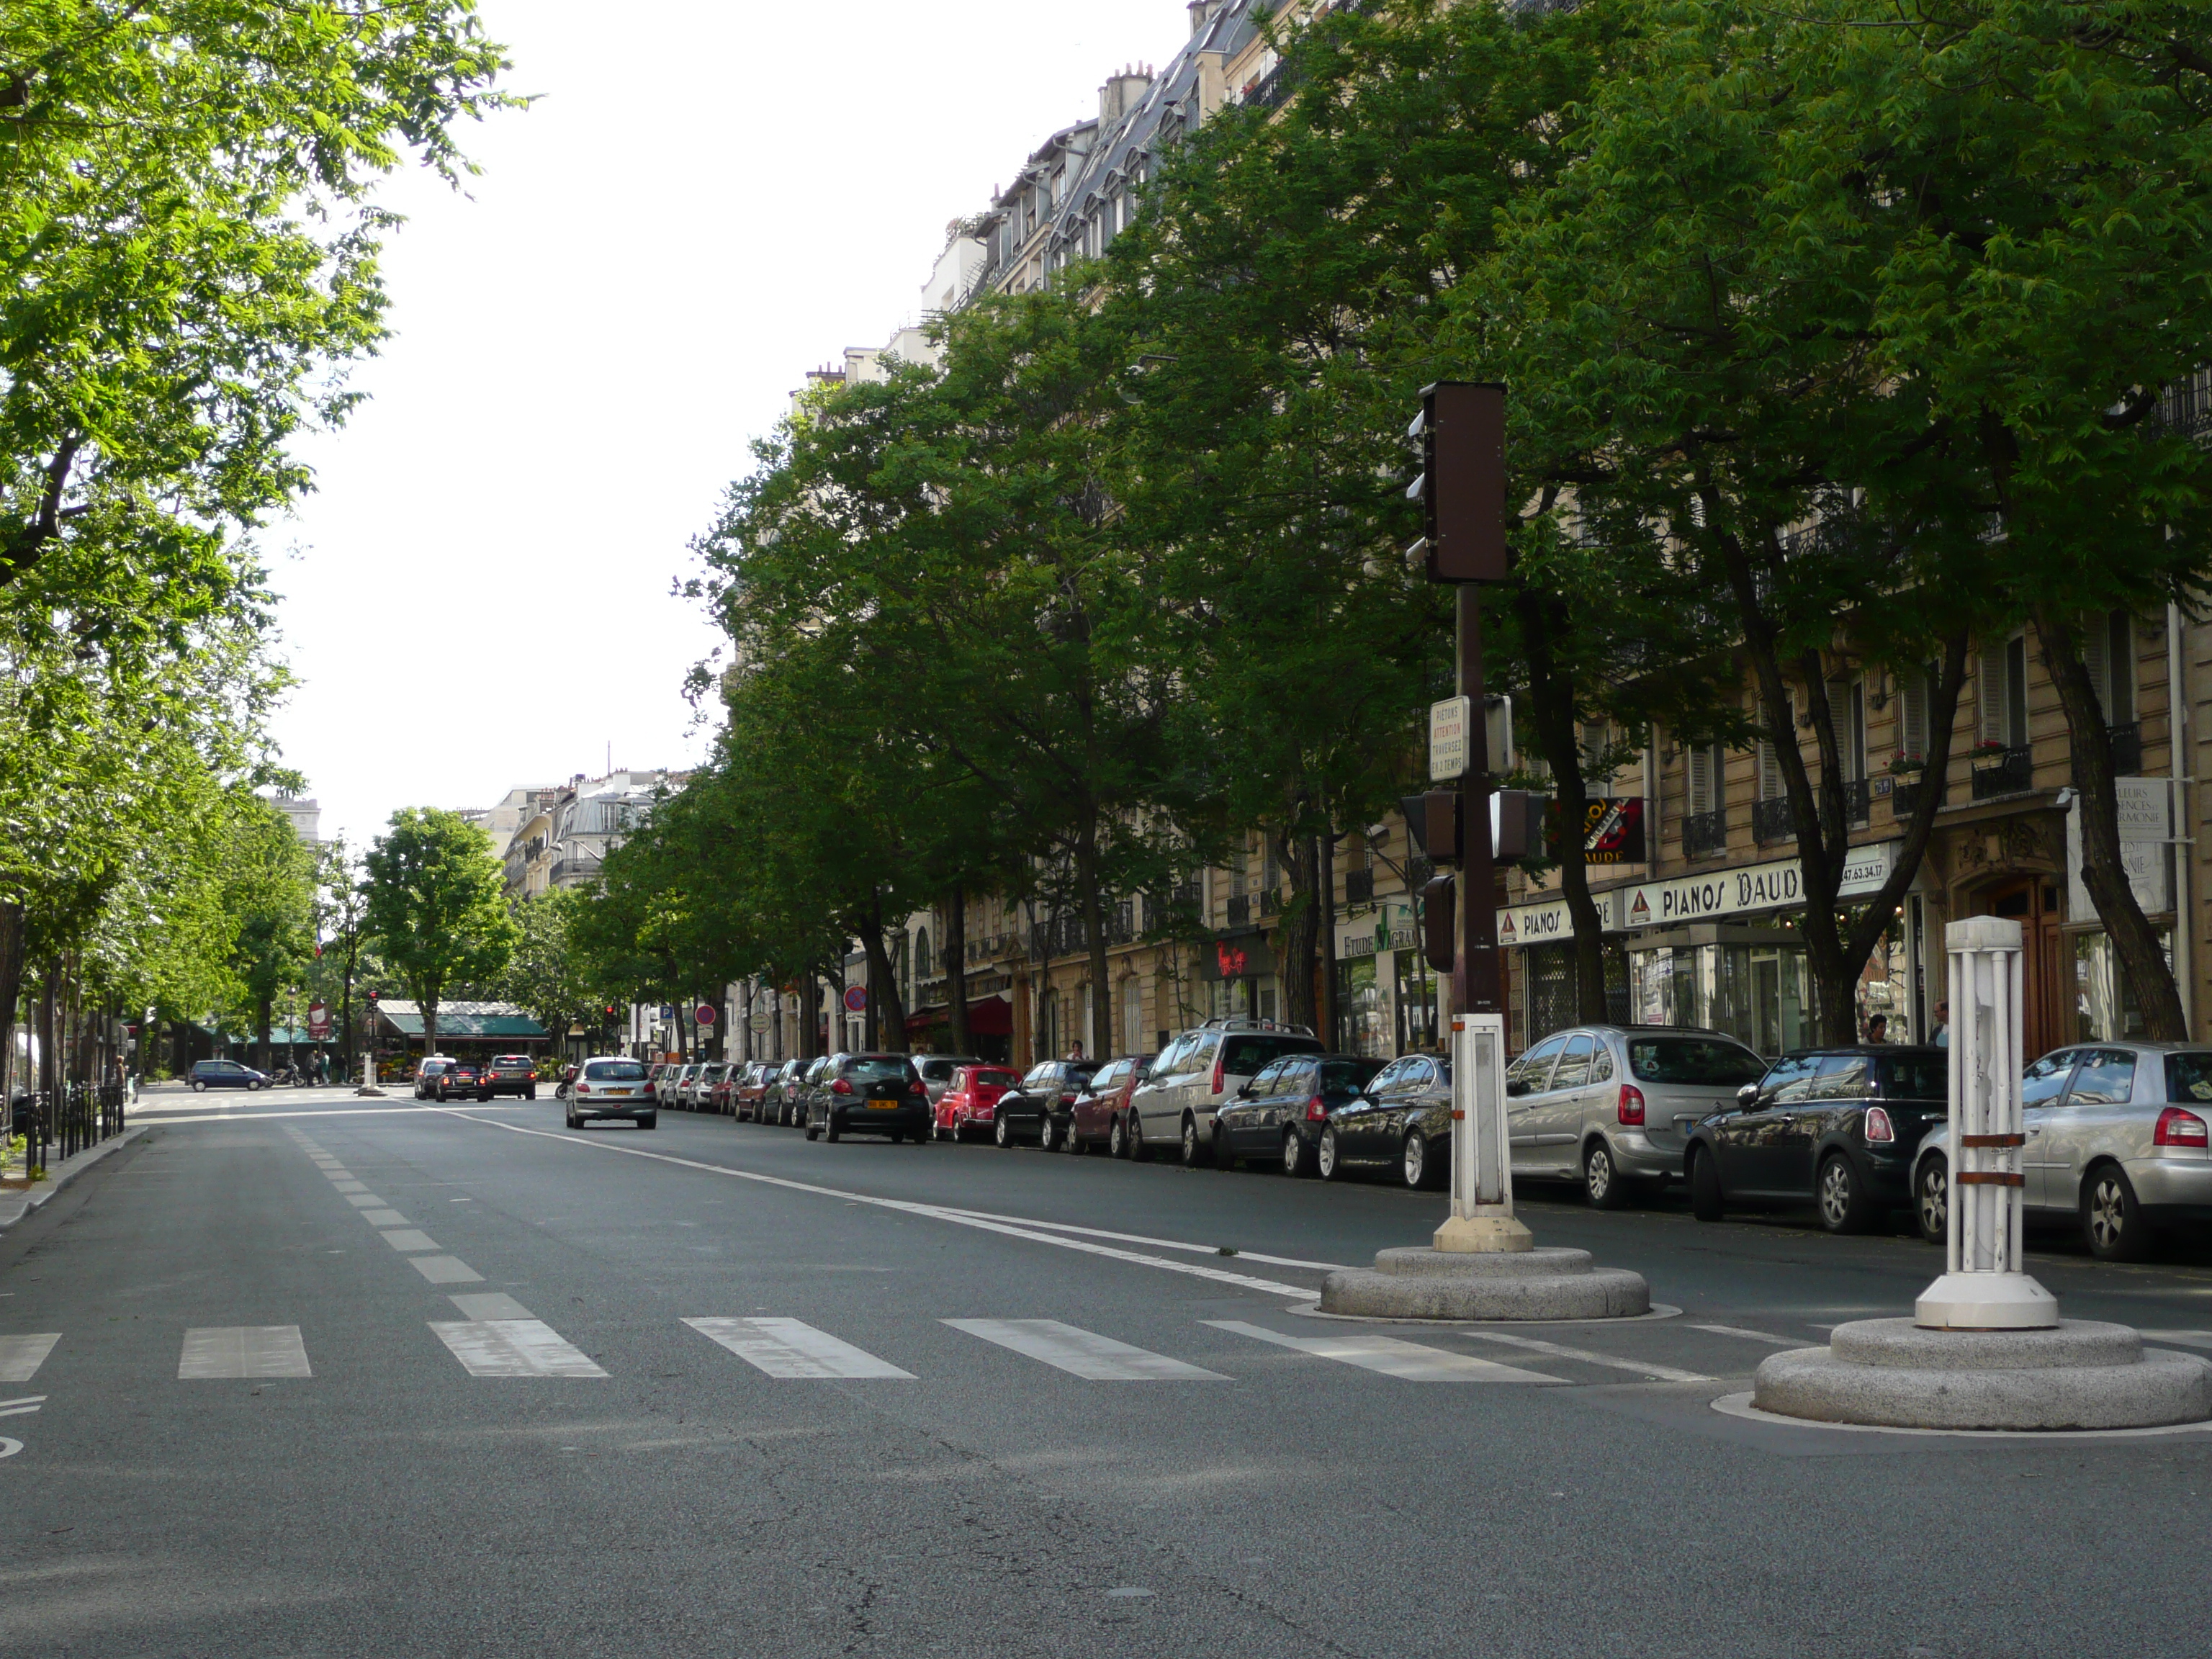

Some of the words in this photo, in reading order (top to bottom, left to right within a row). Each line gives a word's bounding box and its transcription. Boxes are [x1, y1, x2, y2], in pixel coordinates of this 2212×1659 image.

[1437, 706, 1458, 721] PIÉTONS
[1434, 723, 1461, 739] ATTENTION
[1432, 739, 1462, 757] TRAVERSEZ
[1431, 762, 1439, 773] EN
[1439, 761, 1444, 772] 2
[1444, 757, 1462, 770] TEMPS
[2116, 788, 2148, 799] LEURS
[2118, 812, 2160, 823] RMONIE
[1663, 881, 1725, 917] PIANOS
[1737, 868, 1806, 907] DAUD
[1524, 909, 1560, 935] PIANOS
[1344, 935, 1374, 957] ETUDE
